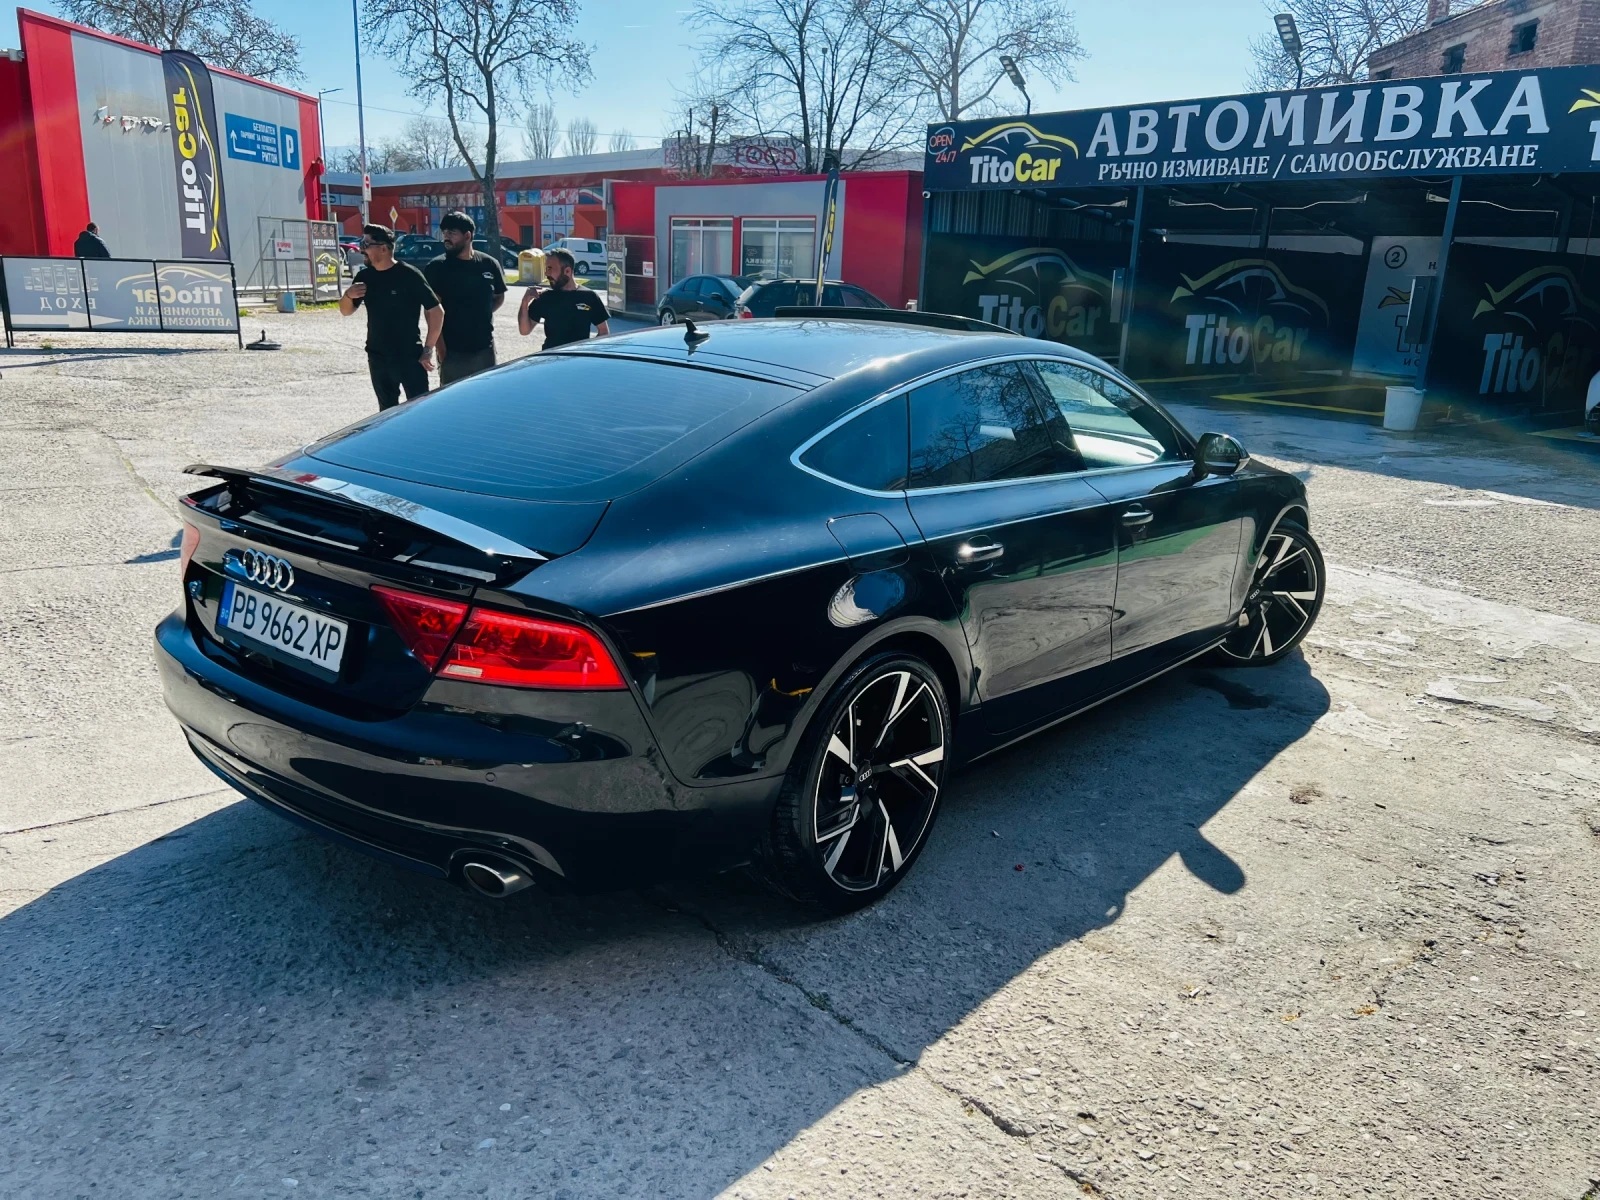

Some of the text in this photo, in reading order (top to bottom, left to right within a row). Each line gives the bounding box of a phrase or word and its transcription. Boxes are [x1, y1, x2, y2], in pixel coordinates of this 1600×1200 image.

[1086, 75, 1550, 158] АВТОМИВКА
[285, 133, 295, 163] P
[929, 134, 953, 148] OPEN
[935, 151, 957, 163] 24/7
[969, 153, 1062, 184] TitoCar
[1098, 144, 1539, 181] РЪЧНО ИЗМИВАНЕ / САМООБСЛУЖВАНЕ
[1390, 251, 1401, 263] 2
[978, 294, 1101, 338] TitoCar
[1185, 313, 1309, 365] TitoCar
[220, 607, 230, 620] BG
[230, 590, 341, 661] PB 9662 XP
